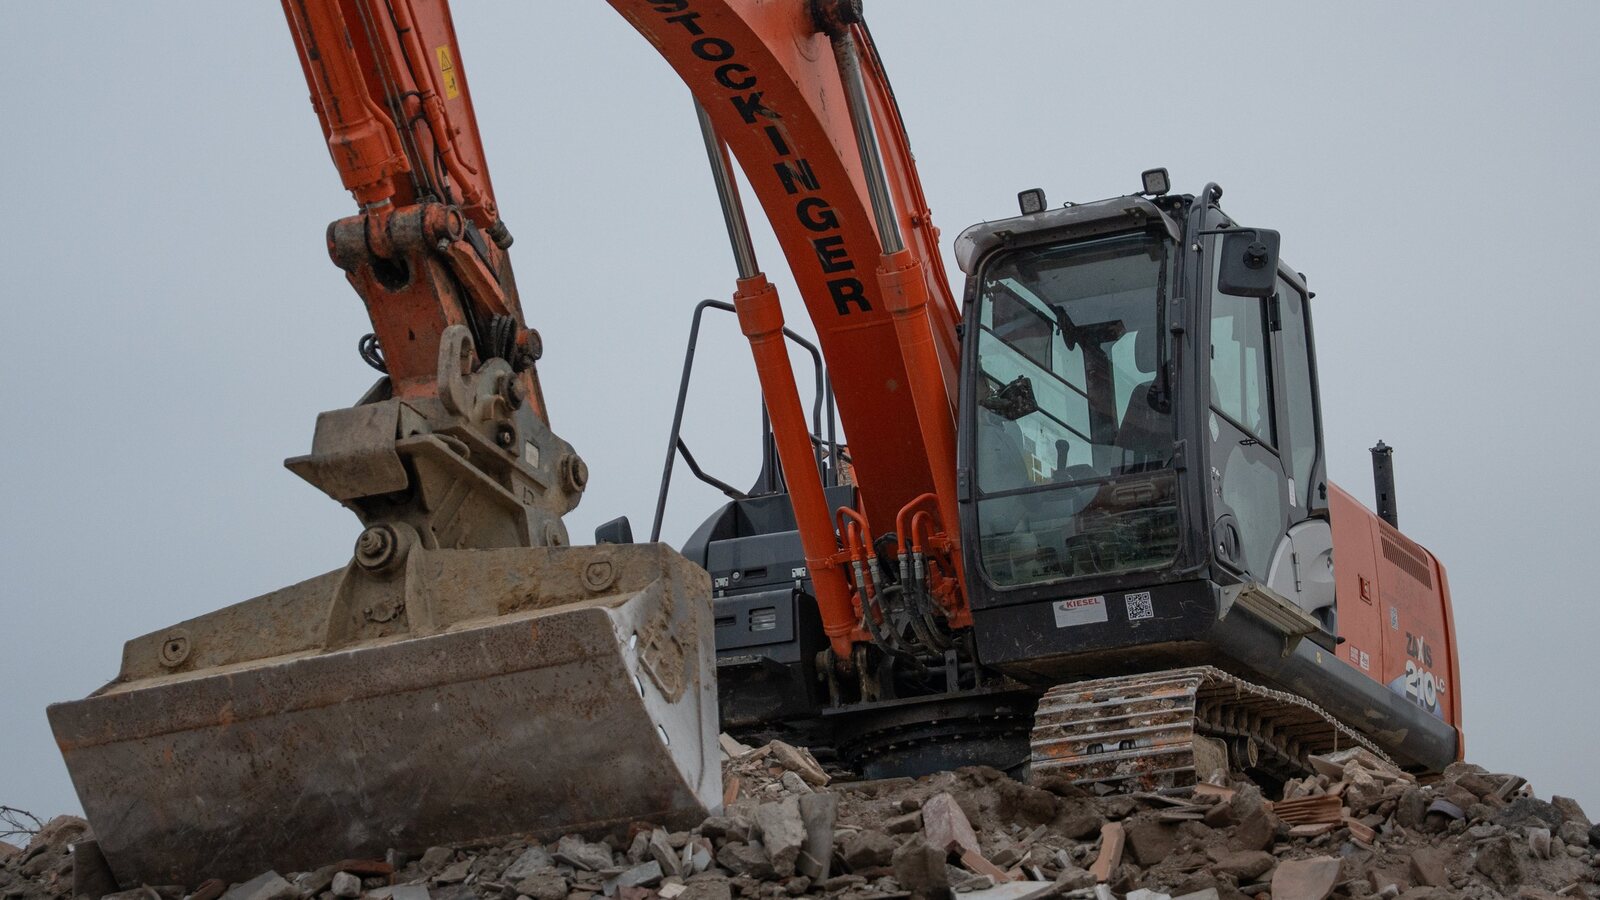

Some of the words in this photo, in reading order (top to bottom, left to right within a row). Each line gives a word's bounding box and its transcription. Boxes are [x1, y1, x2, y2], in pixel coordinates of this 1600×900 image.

[1066, 597, 1101, 609] KIESEL
[1406, 631, 1433, 668] ZAXIS
[1405, 659, 1436, 709] 210
[1435, 675, 1445, 695] LC
